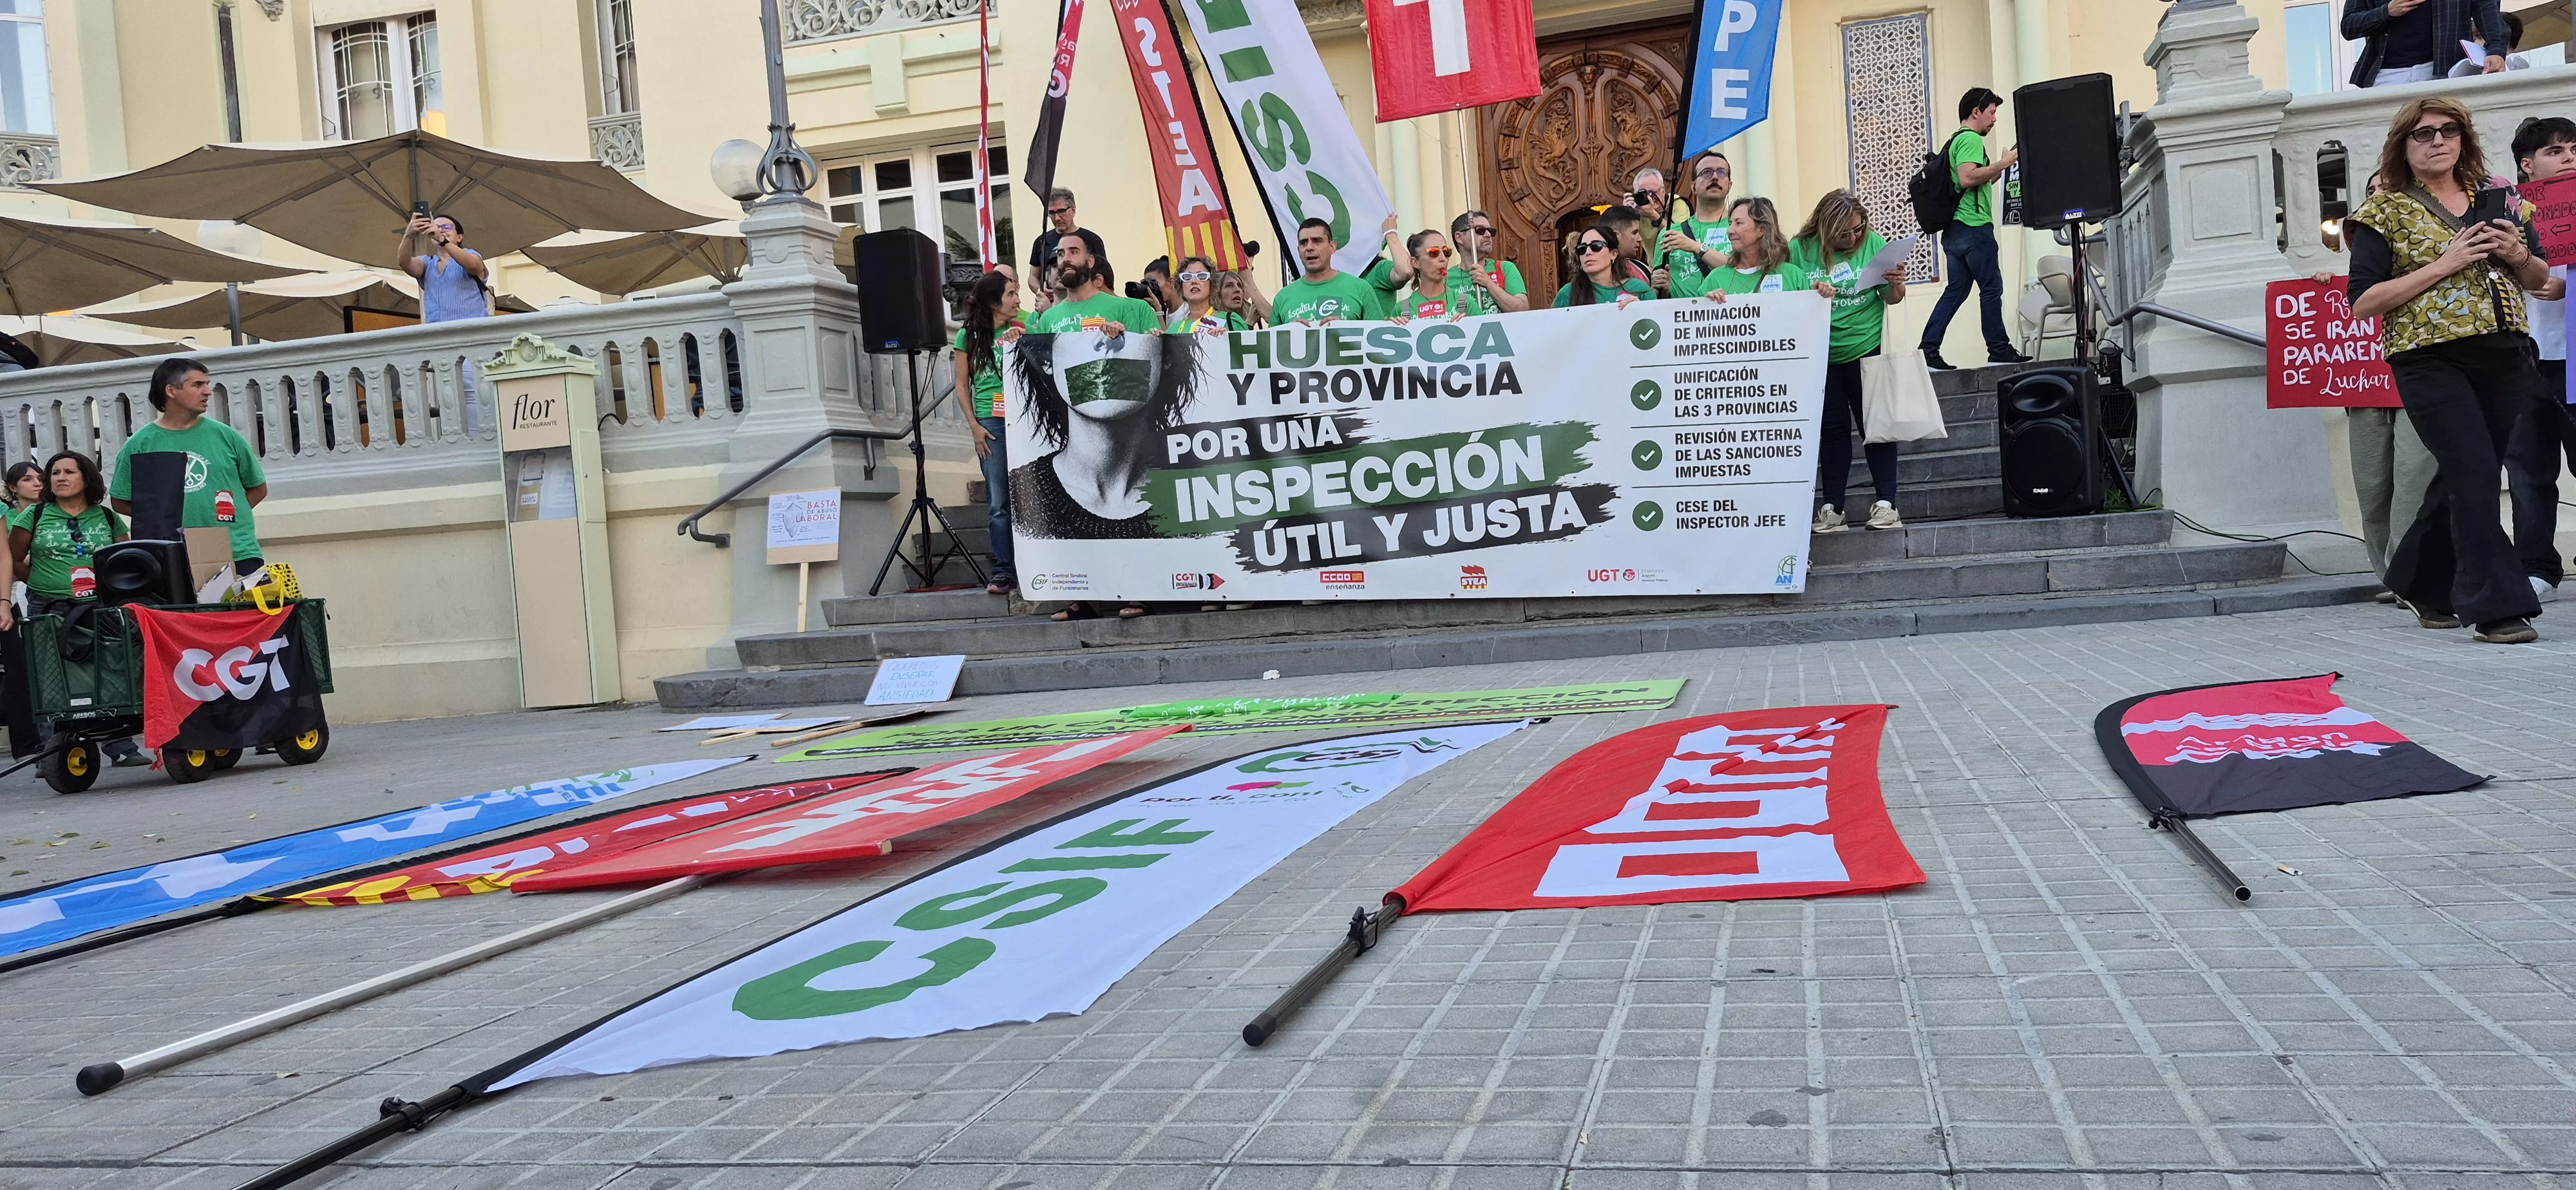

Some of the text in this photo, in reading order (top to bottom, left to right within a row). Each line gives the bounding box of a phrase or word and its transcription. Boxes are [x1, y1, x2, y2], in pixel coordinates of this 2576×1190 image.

[1419, 305, 1433, 313] UGT
[2275, 291, 2316, 318] DE
[1673, 306, 1761, 323] ELIMINACIÓN
[1674, 321, 1757, 340] DE MÍNIMOS
[2285, 321, 2316, 340] SE
[1227, 321, 1515, 371] HUESCA
[1674, 338, 1796, 357] IMPRESCINDIBLES
[2284, 341, 2384, 366] PARAREM
[1227, 361, 1522, 406] Y PROVINCIA
[1674, 367, 1759, 384] UNIFICACIÓN
[2283, 367, 2391, 397] DE Luchar
[1674, 383, 1788, 401] DE CRITERIOS EN
[513, 393, 555, 430] flor
[1674, 400, 1798, 418] LAS 3 PROVINCIAS
[519, 420, 558, 430] RESTAURANTE
[1166, 415, 1343, 464] POR UNA
[1675, 428, 1803, 445] REVISIÓN EXTERNA
[1675, 444, 1803, 461] DE LAS SANCIONES
[1174, 431, 1546, 524] INSPECCIÓN
[1676, 463, 1752, 478] IMPUESTAS
[807, 500, 837, 509] BASTA
[1676, 498, 1738, 514] CESE DEL
[795, 514, 837, 523] LABORAL
[1676, 514, 1786, 530] INSPECTOR JEFE
[1253, 491, 1589, 567] ÚTIL Y JUSTA
[1587, 569, 1620, 582] UGT
[173, 634, 291, 702] CGT
[887, 660, 938, 672] QUEREMOS
[876, 688, 934, 701] ANSIEDAD
[882, 728, 978, 739] POR
[987, 723, 1058, 732] UN
[1338, 687, 1649, 710] INSPECCIÓN
[895, 728, 1087, 744] QUEREMOS
[1245, 709, 1419, 722] CONSEJO
[1464, 698, 1605, 710] AYUDA
[1251, 718, 1341, 727] sindical
[732, 818, 1214, 1021] CSIF
